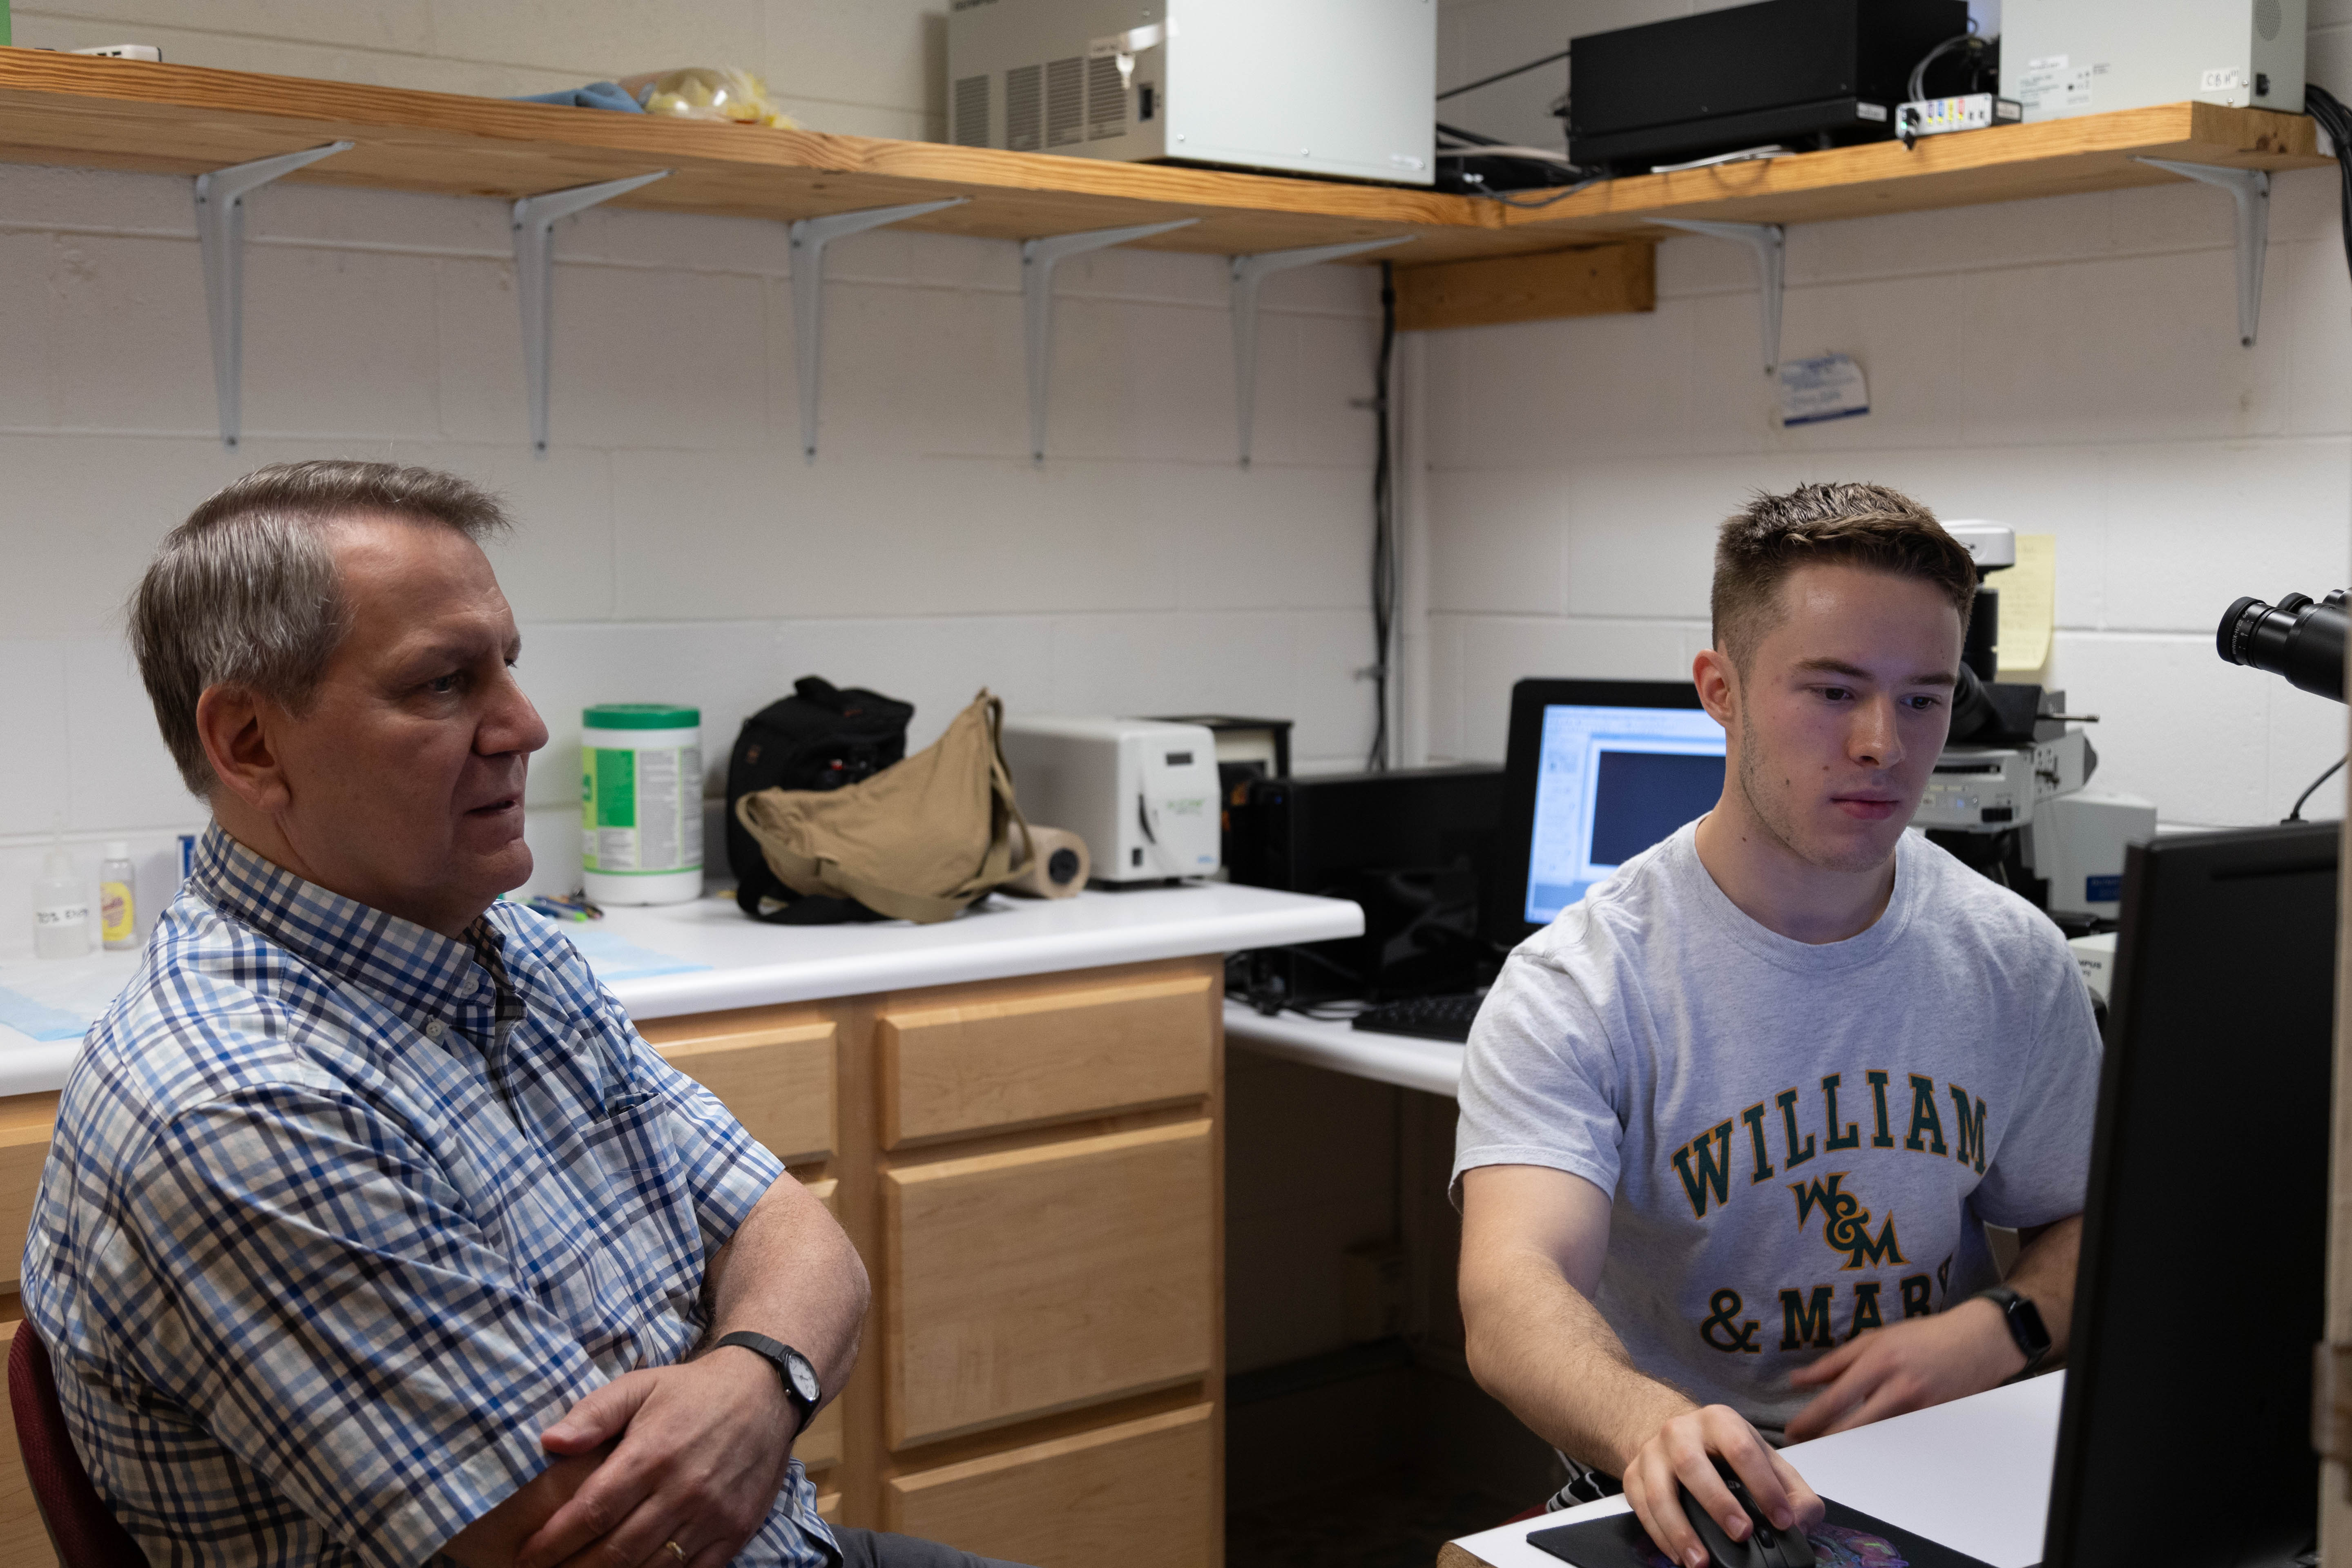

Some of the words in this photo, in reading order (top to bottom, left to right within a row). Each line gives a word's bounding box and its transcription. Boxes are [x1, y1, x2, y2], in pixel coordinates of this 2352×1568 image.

[1670, 1069, 1987, 1221] WILLIAM
[1785, 1171, 1912, 1271] W&M
[1700, 1287, 1761, 1354] &
